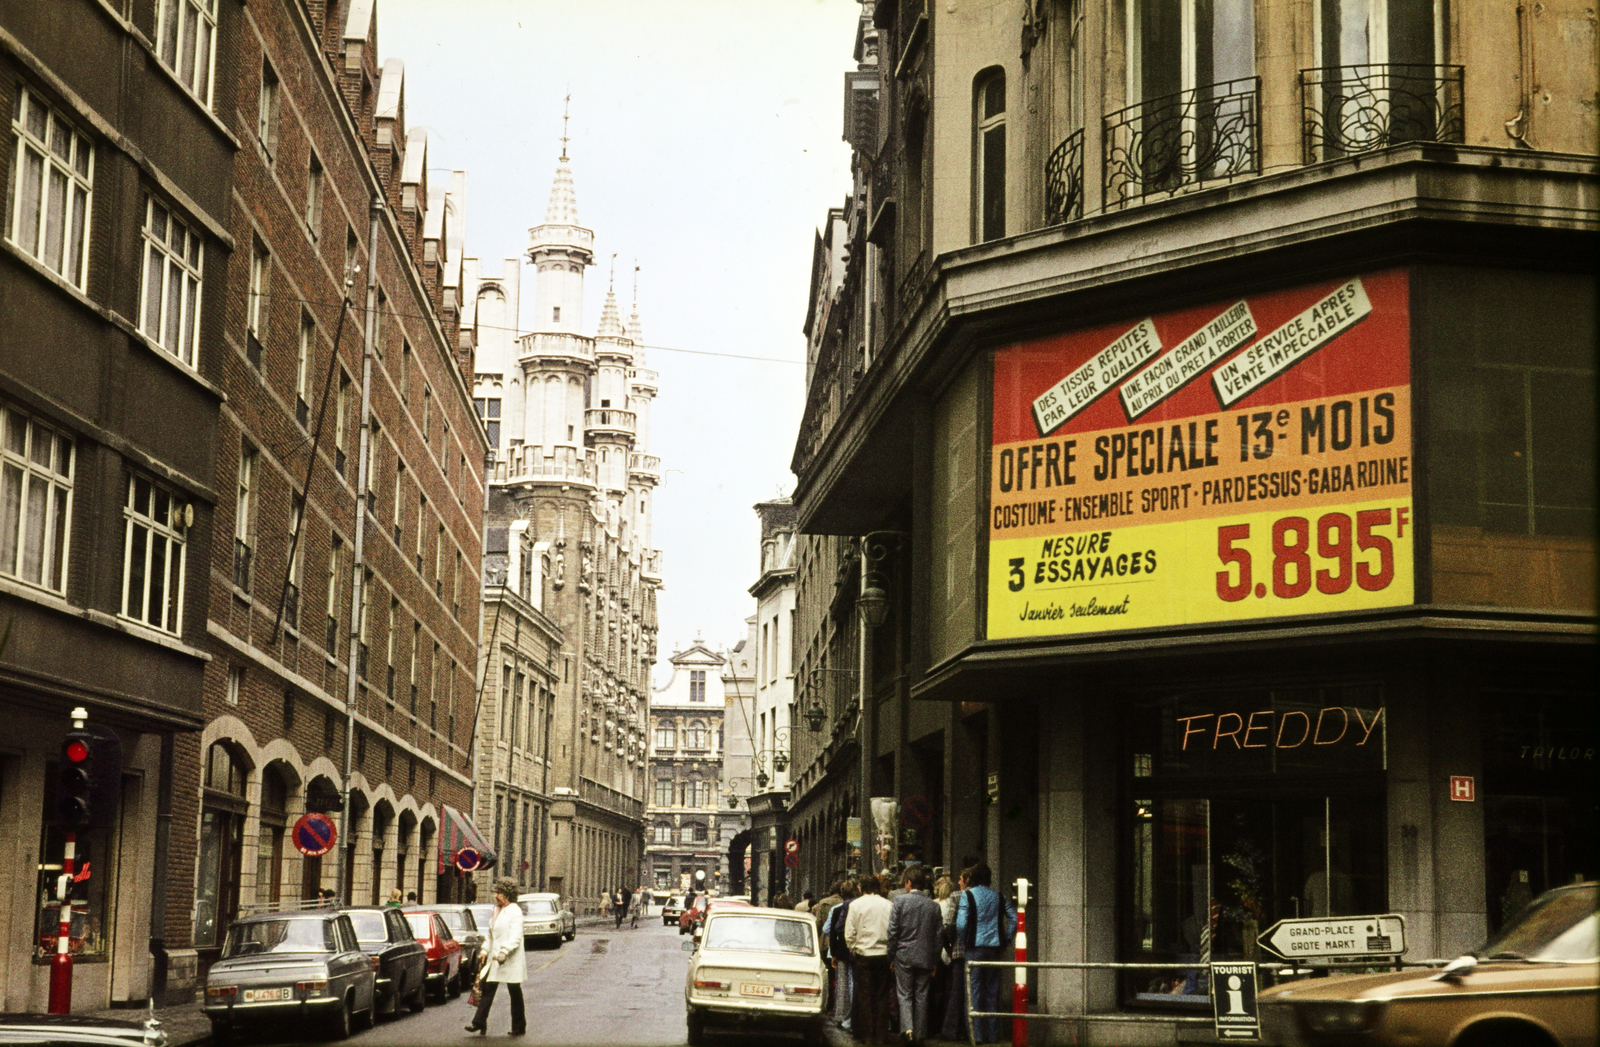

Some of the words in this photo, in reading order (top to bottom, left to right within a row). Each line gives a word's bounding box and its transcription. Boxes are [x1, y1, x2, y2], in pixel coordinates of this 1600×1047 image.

[1124, 379, 1143, 399] UNE
[1175, 331, 1207, 363] GRAND
[1207, 302, 1248, 339] TAILLEUR
[1220, 362, 1239, 383] UN
[1246, 318, 1304, 365] SERVICE
[1311, 284, 1356, 323] APRES
[1224, 361, 1266, 396] VENTE
[1268, 302, 1355, 368] IMPECCABLE
[1038, 391, 1058, 413] DES
[1060, 363, 1096, 397] TISSUS
[1097, 323, 1149, 370] REPUTES
[1043, 404, 1067, 427] PAR
[1068, 380, 1098, 409] LEUR
[1102, 340, 1153, 385] QUALITE
[1131, 399, 1143, 414] AU
[1143, 382, 1164, 406] PRIX
[1165, 370, 1181, 389] DU
[1180, 351, 1207, 378] PRET
[1209, 345, 1217, 360] A
[1216, 317, 1256, 353] PORTER
[1000, 440, 1077, 493] OFFRE
[1093, 419, 1219, 482] SPECIALE
[1301, 392, 1395, 455] MOIS
[1141, 483, 1192, 513] SPORT
[1041, 531, 1112, 560] MESURE
[1008, 557, 1025, 592] 3
[1034, 549, 1157, 584] ESSAYAGES
[1019, 601, 1064, 621] Janvier
[1070, 594, 1130, 619] seulement
[1176, 706, 1383, 751] FREDDY
[1520, 745, 1596, 761] TAILOR
[1455, 780, 1471, 798] H
[1289, 925, 1355, 937] GRAND-PLACE
[1291, 941, 1320, 951] GROTE
[1325, 939, 1355, 950] MARKT
[1214, 966, 1253, 974] TOURIST
[283, 988, 290, 999] B
